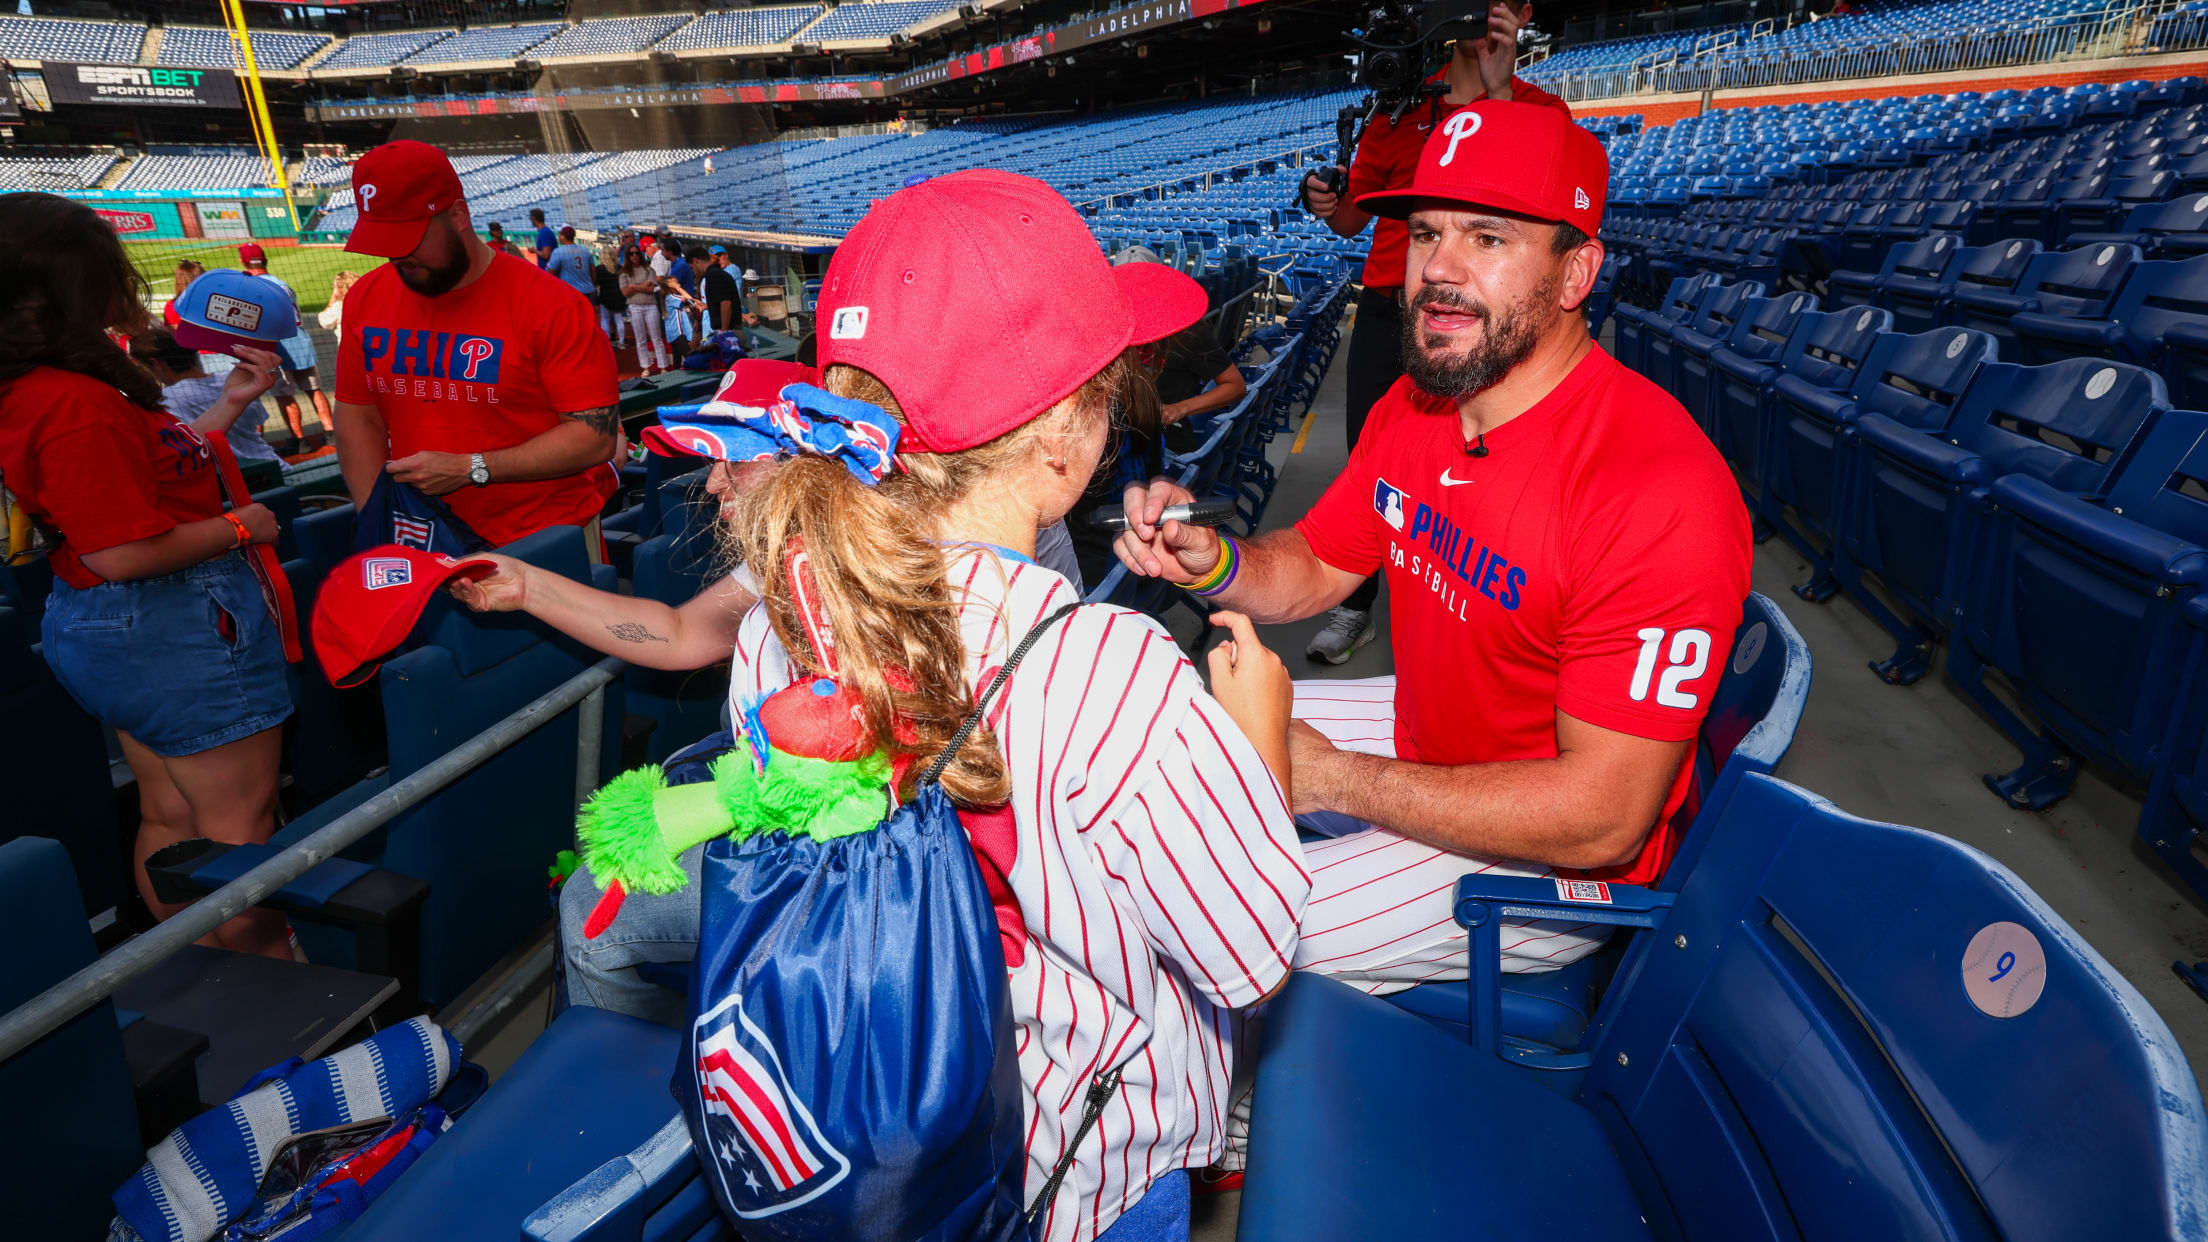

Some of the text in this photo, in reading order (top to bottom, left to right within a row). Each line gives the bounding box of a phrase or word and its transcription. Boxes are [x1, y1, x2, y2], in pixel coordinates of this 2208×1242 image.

[76, 65, 204, 87] ESPN BET
[97, 85, 195, 97] SPORTSBOOK
[1438, 111, 1483, 167] P
[359, 183, 377, 212] P
[98, 214, 147, 229] RR'S
[1409, 502, 1527, 611] PHILLIES
[1390, 540, 1467, 622] BASEBALL
[1629, 627, 1712, 709] 12
[1988, 951, 2016, 983] 9
